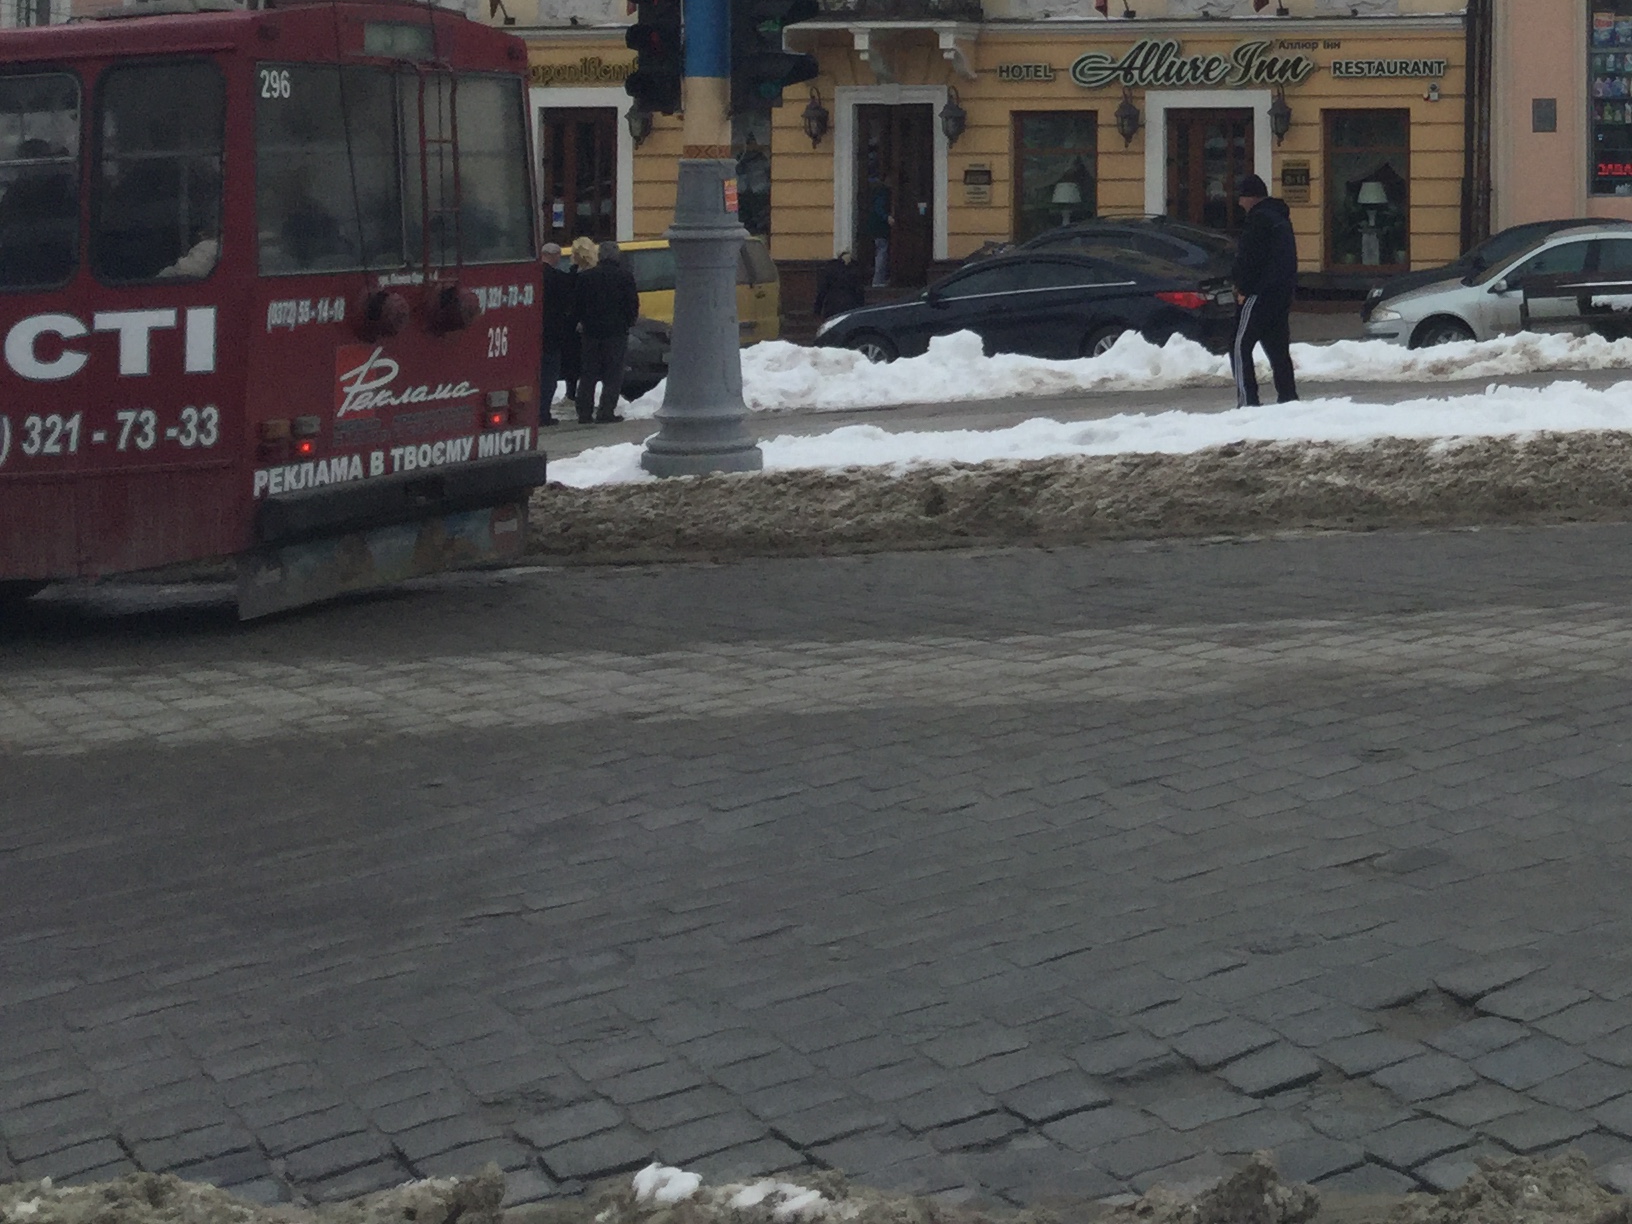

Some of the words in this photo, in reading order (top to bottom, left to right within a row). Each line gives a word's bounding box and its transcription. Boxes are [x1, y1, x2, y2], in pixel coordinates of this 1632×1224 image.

[997, 63, 1055, 80] HOTEL
[1072, 40, 1229, 86] Allure
[1230, 40, 1315, 84] Inn
[1331, 59, 1447, 77] RESTAURANT
[260, 69, 291, 99] 296
[3, 306, 217, 381] СТІ
[487, 325, 509, 358] 296
[337, 345, 480, 417] Реклама
[253, 453, 364, 499] РЕКЛАМА
[370, 449, 385, 477] В
[390, 437, 473, 473] ТВОЄМУ
[477, 427, 531, 459] МІСТІ
